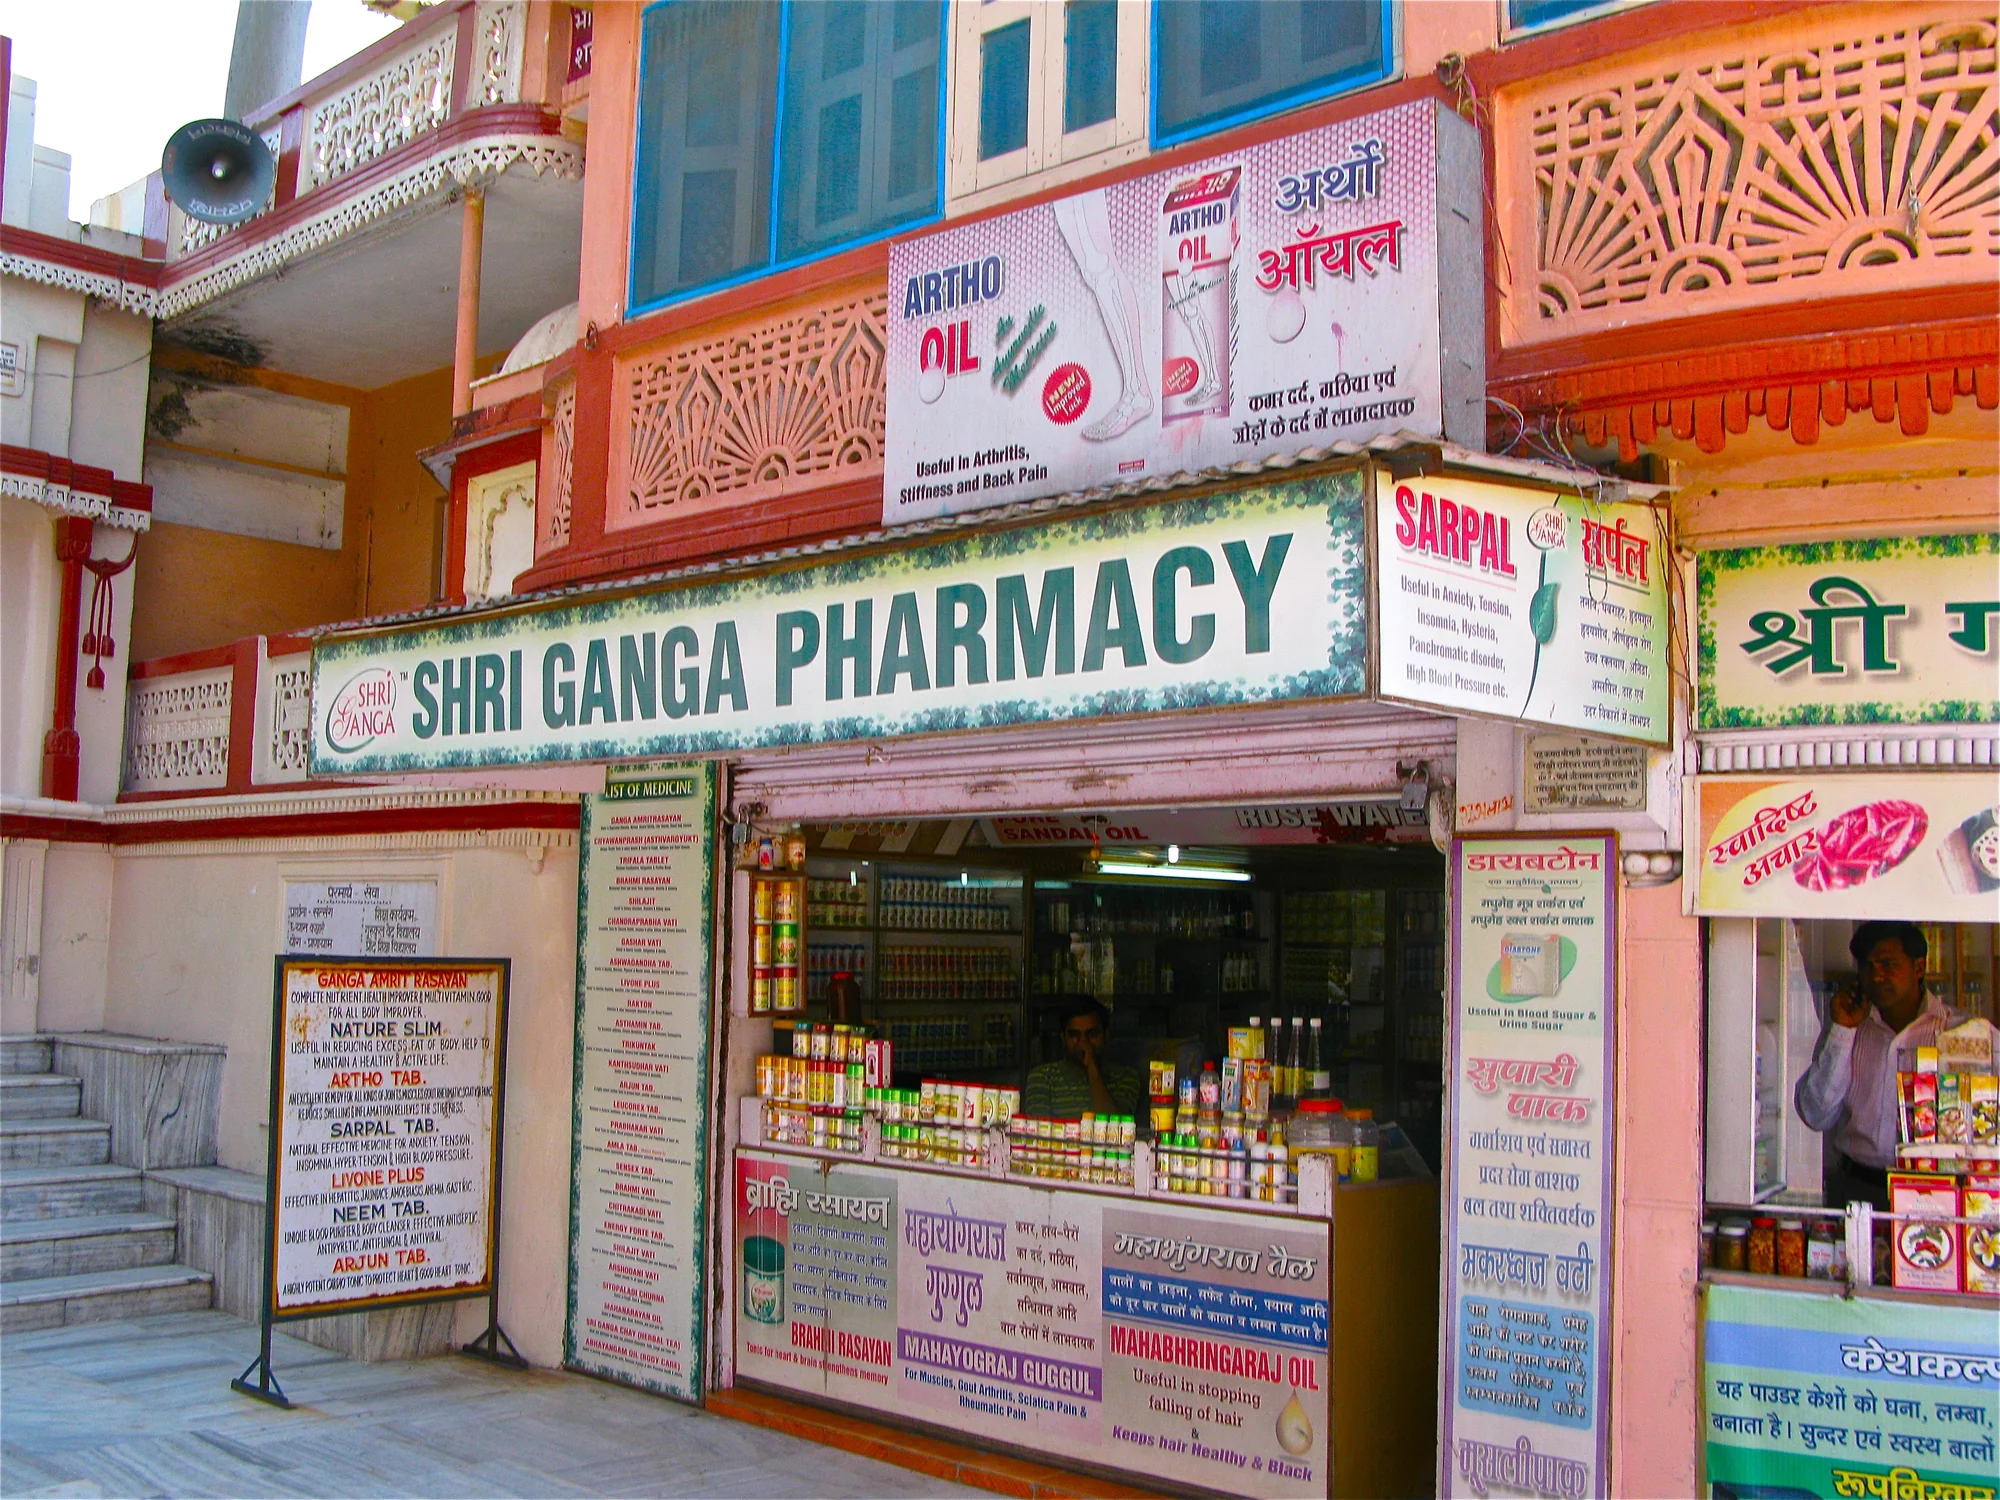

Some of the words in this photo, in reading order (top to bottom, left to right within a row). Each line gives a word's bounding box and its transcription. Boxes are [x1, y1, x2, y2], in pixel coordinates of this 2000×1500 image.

[1169, 203, 1226, 235] ARTHO
[1179, 236, 1212, 261] OIL
[1257, 221, 1404, 290] ऑयल
[903, 256, 1001, 319] ARTHO
[920, 320, 979, 375] OIL
[1049, 372, 1077, 404] NEW
[1287, 380, 1315, 405] दर्द,
[1373, 365, 1397, 392] एवं
[1271, 415, 1287, 437] के
[1289, 409, 1311, 435] दर्द
[1314, 407, 1329, 429] में
[917, 457, 953, 478] Useful
[973, 444, 1030, 468] Arthritis,
[901, 483, 954, 504] Stiffness
[957, 475, 979, 495] and
[983, 469, 1015, 490] Back
[1019, 464, 1048, 484] Pain
[1396, 486, 1516, 576] SARPAL
[1581, 518, 1649, 581] सर्पल
[1400, 575, 1430, 598] Useful
[1431, 580, 1440, 600] in
[1442, 585, 1476, 613] Anxiety,
[1478, 595, 1512, 621] Tension,
[413, 650, 522, 739] SHRI
[542, 620, 749, 729] GANGA
[775, 532, 1295, 708] PHARMACY
[1417, 607, 1460, 636] Insomnia,
[1462, 617, 1499, 645] Hysteria,
[1739, 575, 1906, 675] श्री
[1409, 636, 1468, 664] Panchromatic
[1471, 646, 1506, 674] disorder,
[358, 670, 391, 708] SHRI
[1406, 664, 1426, 684] High
[1429, 667, 1453, 687] Blood
[1455, 674, 1490, 697] Pressure
[1492, 679, 1510, 699] etc.
[605, 782, 626, 799] LIST
[627, 782, 641, 798] OF
[643, 780, 693, 797] MEDICINE
[1105, 825, 1149, 840] OIL
[1236, 807, 1323, 828] ROSE
[1467, 846, 1600, 871] डायबटोन
[1742, 827, 1820, 887] अचार
[1568, 895, 1586, 910] एवं
[318, 972, 364, 988] GANGA
[369, 971, 409, 988] AMRIT
[413, 972, 467, 989] RASAYAN
[329, 1007, 342, 1018] FOR
[346, 1007, 358, 1018] ALL
[361, 1006, 380, 1018] BODY
[383, 1006, 426, 1019] IMPROVER.
[1467, 1007, 1502, 1017] Useful
[1504, 1007, 1515, 1017] in
[1518, 1008, 1549, 1019] Blood
[1551, 1010, 1586, 1021] Sugar
[1588, 1011, 1598, 1020] &
[1499, 1020, 1529, 1030] Urine
[1531, 1021, 1564, 1032] Sugar
[330, 1022, 397, 1039] NATURE
[403, 1021, 441, 1037] SLIM
[331, 1071, 383, 1088] ARTHO
[390, 1070, 427, 1085] TAB.
[1466, 1053, 1579, 1094] सुपारी
[613, 1100, 645, 1113] LEUCOREX
[1506, 1093, 1592, 1121] पाक
[330, 1121, 396, 1138] SARPAL
[403, 1118, 439, 1134] TAB.
[1526, 1130, 1546, 1158] एवं
[1549, 1135, 1591, 1160] समस्त
[331, 1172, 385, 1189] LIVONE
[388, 1167, 425, 1184] PLUS
[1507, 1162, 1532, 1187] रोग
[1534, 1170, 1580, 1192] नाशक
[333, 1203, 386, 1224] NEEM
[392, 1200, 429, 1216] TAB.
[805, 1190, 892, 1231] रसायन
[1463, 1197, 1486, 1218] बल
[1488, 1200, 1517, 1219] तथा
[904, 1197, 1007, 1262] महायोगराज
[332, 1252, 389, 1273] ARJUN
[395, 1248, 431, 1265] TAB.
[1460, 1243, 1550, 1288] मकरध्वज
[1555, 1241, 1594, 1294] वटी
[926, 1264, 984, 1328] गुग्गुल
[839, 1331, 893, 1367] RASAYAN
[903, 1333, 1018, 1381] MAHAYOGRAJ
[1022, 1358, 1095, 1397] GUGGUL
[1110, 1323, 1282, 1384] MAHABHRINGARAJ
[1288, 1356, 1320, 1391] OIL
[904, 1368, 917, 1380] For
[919, 1370, 956, 1391] Muscles,
[958, 1379, 977, 1393] Gout
[979, 1383, 1017, 1403] Arthritis,
[1018, 1392, 1054, 1412] Sciatica
[1056, 1401, 1078, 1416] Pain
[1080, 1406, 1087, 1418] &
[1132, 1367, 1178, 1391] Useful
[1180, 1374, 1195, 1393] in
[1198, 1382, 1261, 1410] stopping
[1716, 1380, 1743, 1400] यह
[1749, 1381, 1801, 1405] पाउडर
[1806, 1383, 1847, 1411] केशों
[1853, 1388, 1878, 1415] को
[1884, 1397, 1927, 1423] घना,
[1935, 1401, 1993, 1430] लम्बा,
[959, 1395, 1003, 1415] Rheumatic
[1006, 1407, 1027, 1421] Pain
[1148, 1394, 1193, 1420] falling
[1197, 1404, 1212, 1420] of
[1215, 1408, 1244, 1428] hair
[1191, 1427, 1200, 1440] &
[1711, 1412, 1763, 1436] बनाता
[1798, 1422, 1848, 1449] सुन्दर
[1854, 1425, 1883, 1449] एवं
[1888, 1434, 1941, 1456] स्वस्थ
[1949, 1434, 1995, 1462] बालों
[1112, 1425, 1156, 1448] Keeps
[1158, 1433, 1189, 1453] hair
[1191, 1442, 1246, 1468] Healthy
[1251, 1456, 1263, 1471] &
[1267, 1459, 1313, 1482] Black
